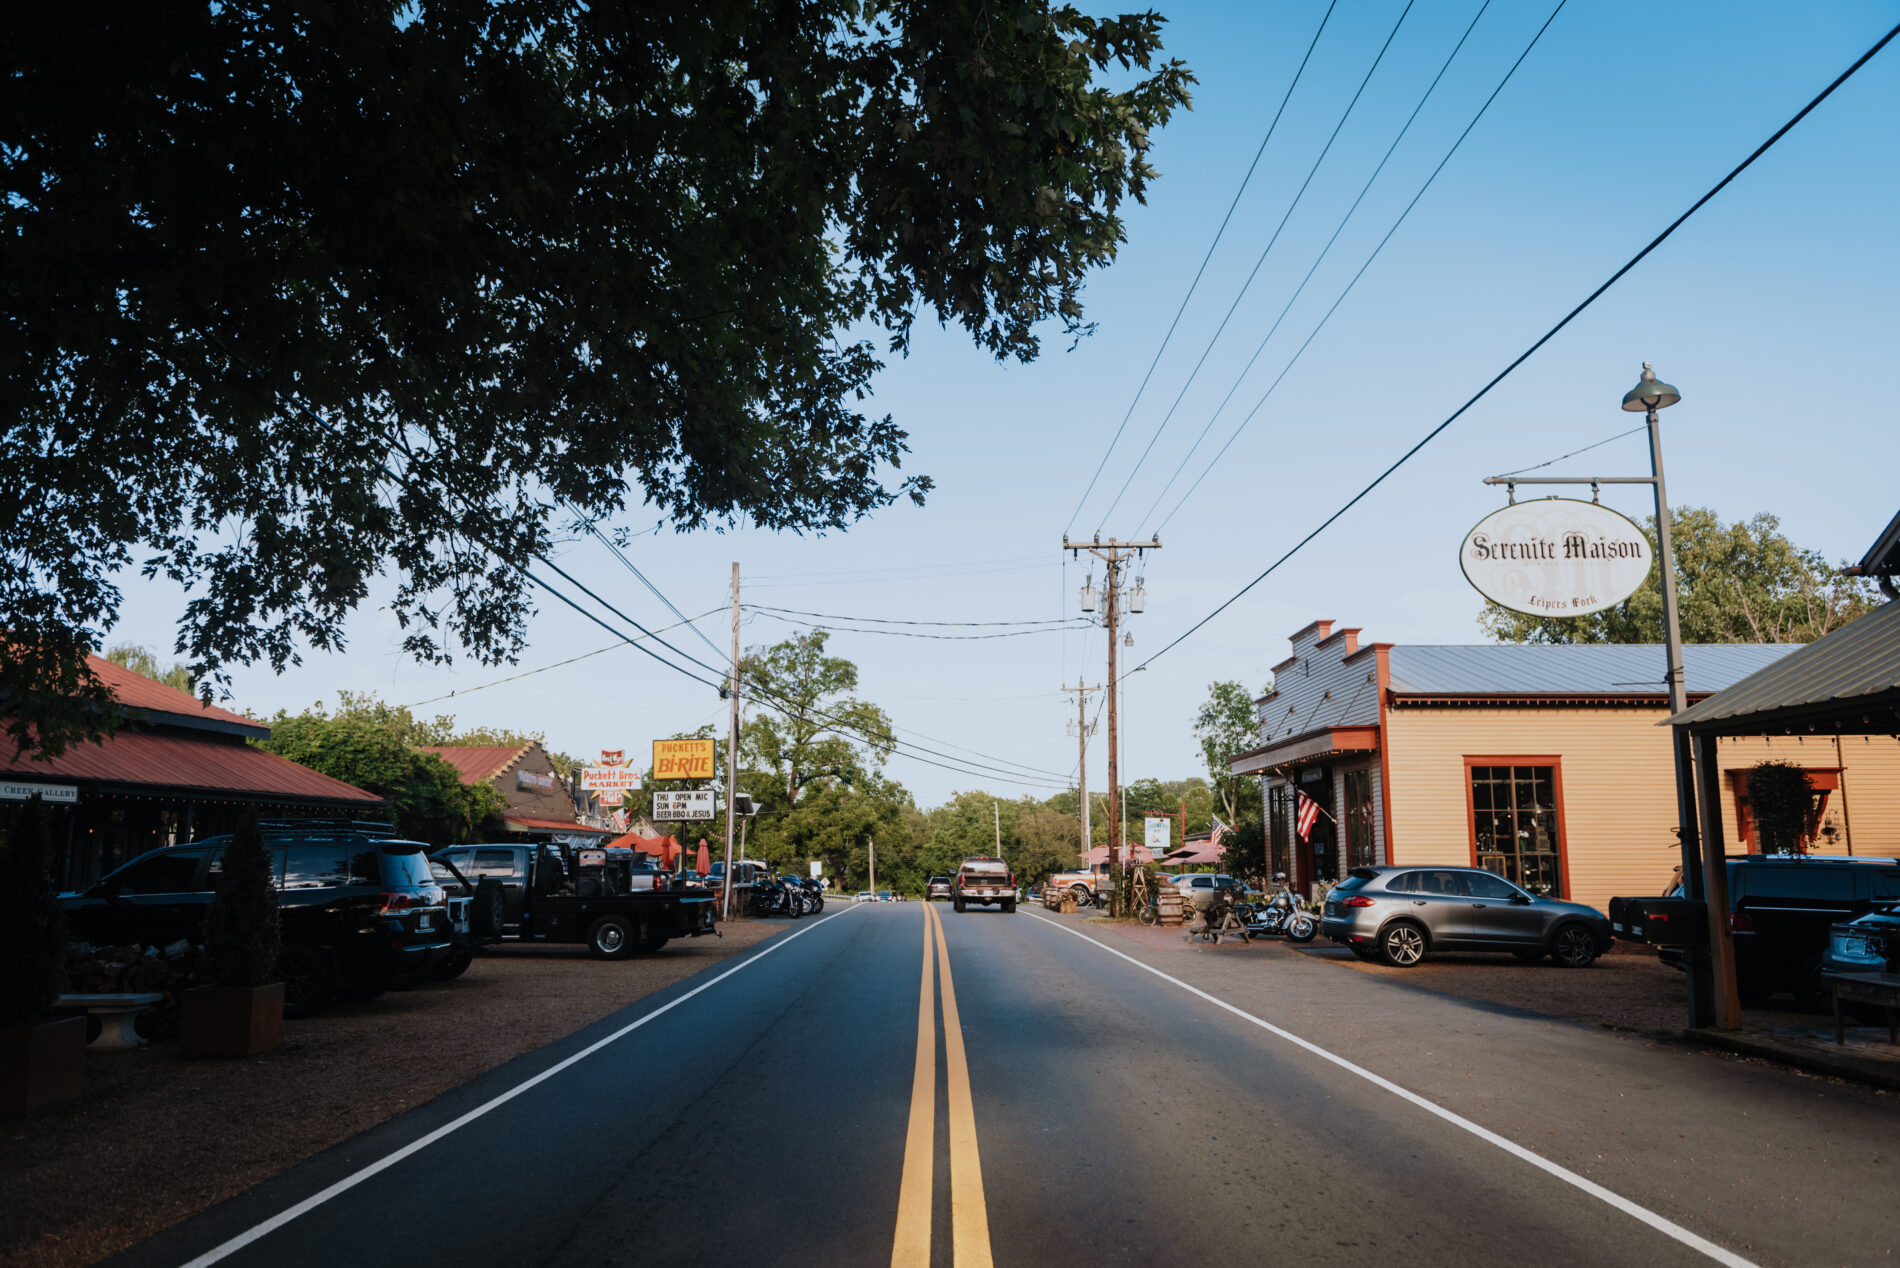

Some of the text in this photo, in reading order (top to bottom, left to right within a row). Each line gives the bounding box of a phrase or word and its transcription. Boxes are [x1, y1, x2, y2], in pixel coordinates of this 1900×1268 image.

[1470, 531, 1643, 561] Serenite Maison
[1571, 593, 1598, 608] Fork
[661, 742, 707, 753] PUCKETT'S
[583, 770, 616, 780] Puckett
[656, 793, 708, 801] THU OPEN MIC
[656, 802, 687, 810] SUN 6PM
[656, 811, 672, 819] BEER
[672, 810, 686, 818] BBQ
[691, 810, 711, 818] JESUS
